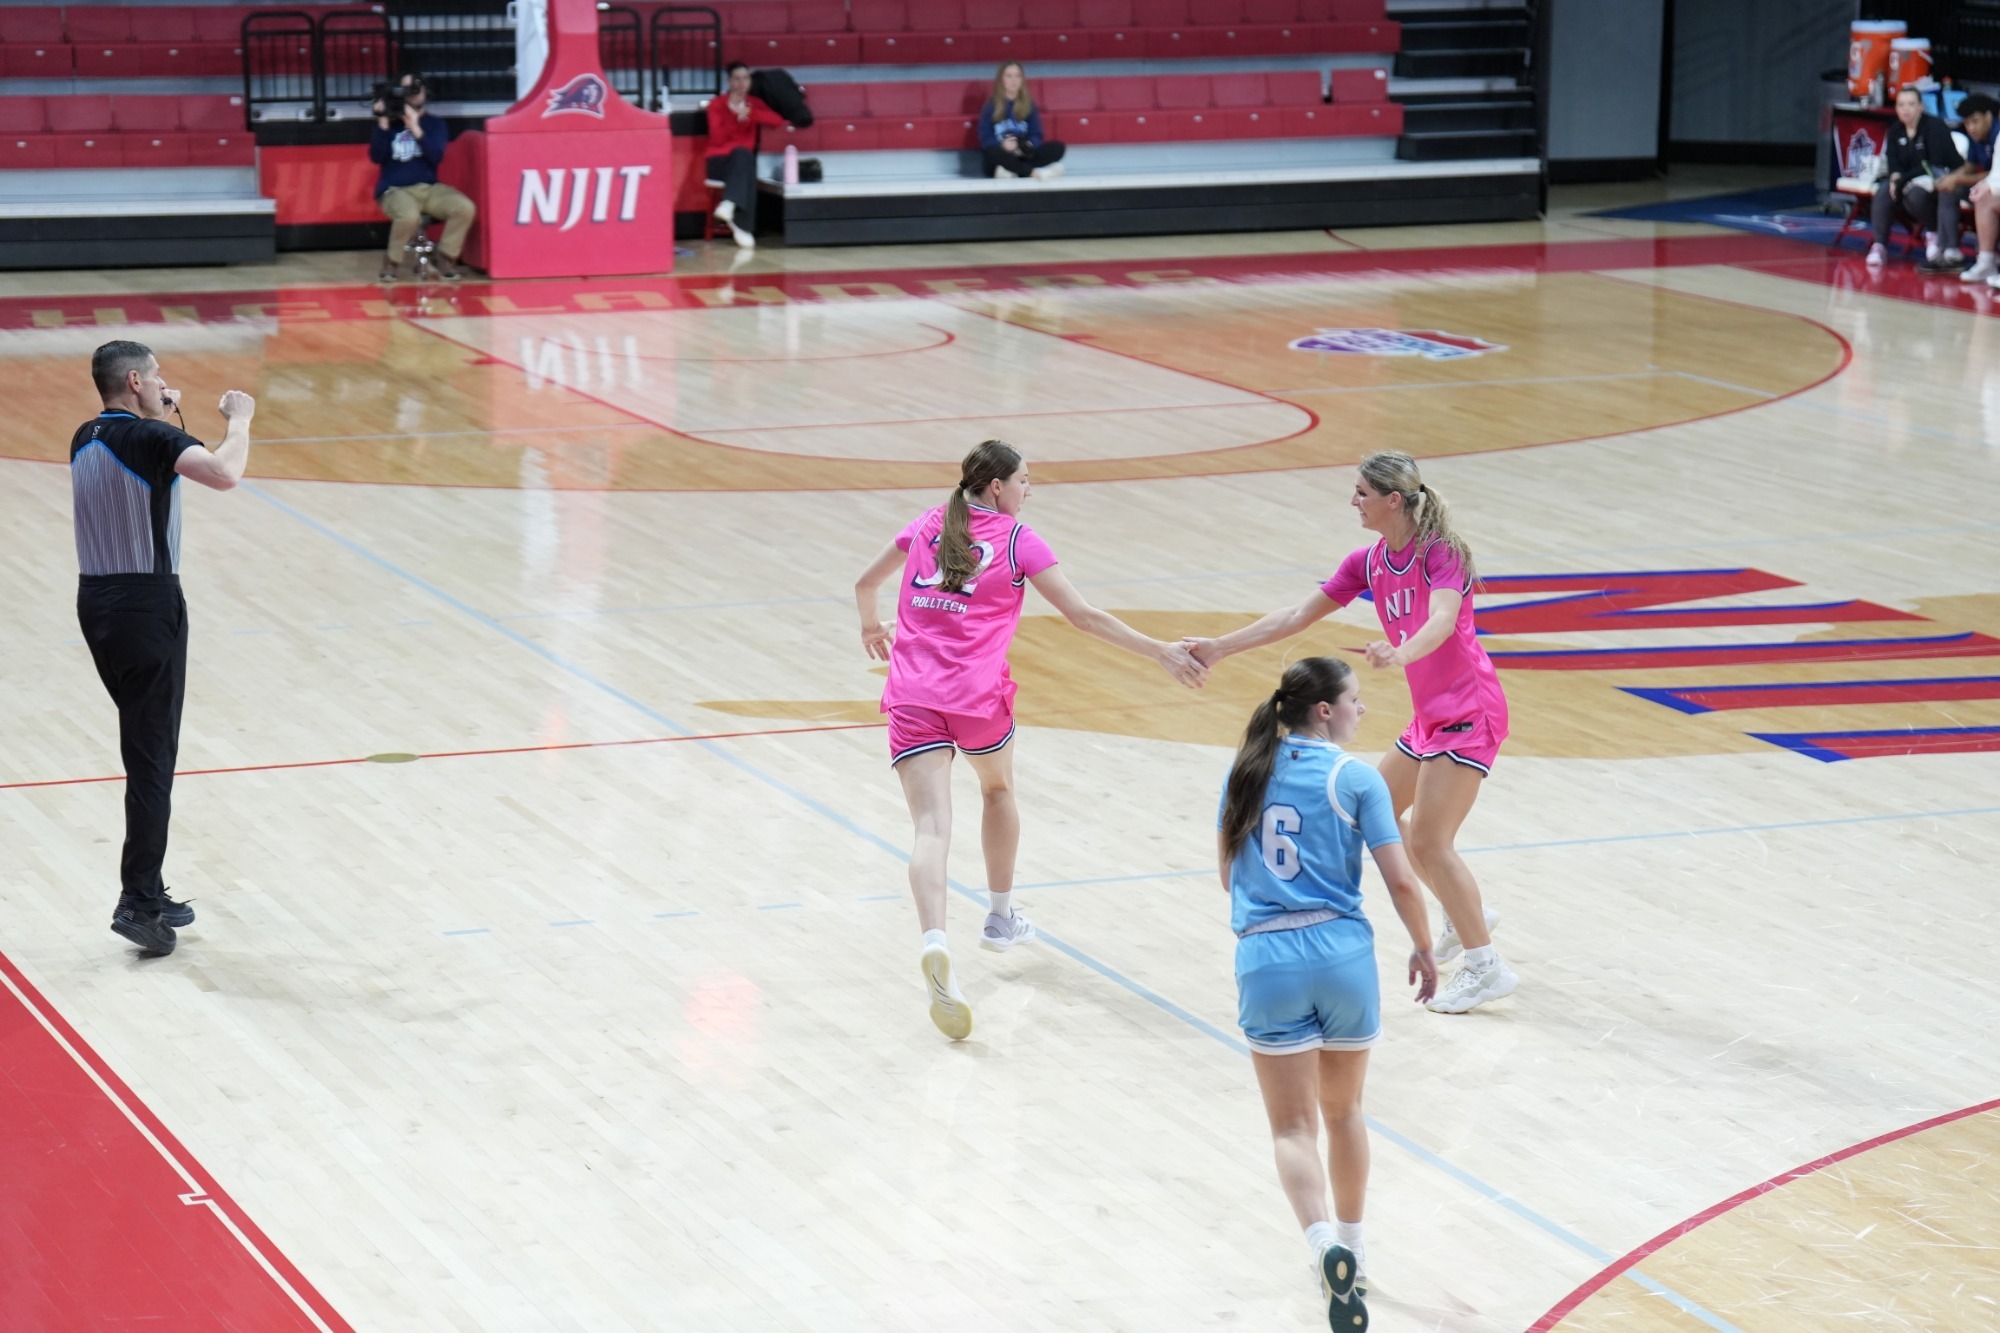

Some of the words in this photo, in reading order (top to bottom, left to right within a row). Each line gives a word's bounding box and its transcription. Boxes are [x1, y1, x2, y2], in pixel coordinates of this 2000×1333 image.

[515, 166, 652, 232] NJIT
[911, 595, 969, 614] ROLLTECH
[1261, 802, 1303, 882] 6
